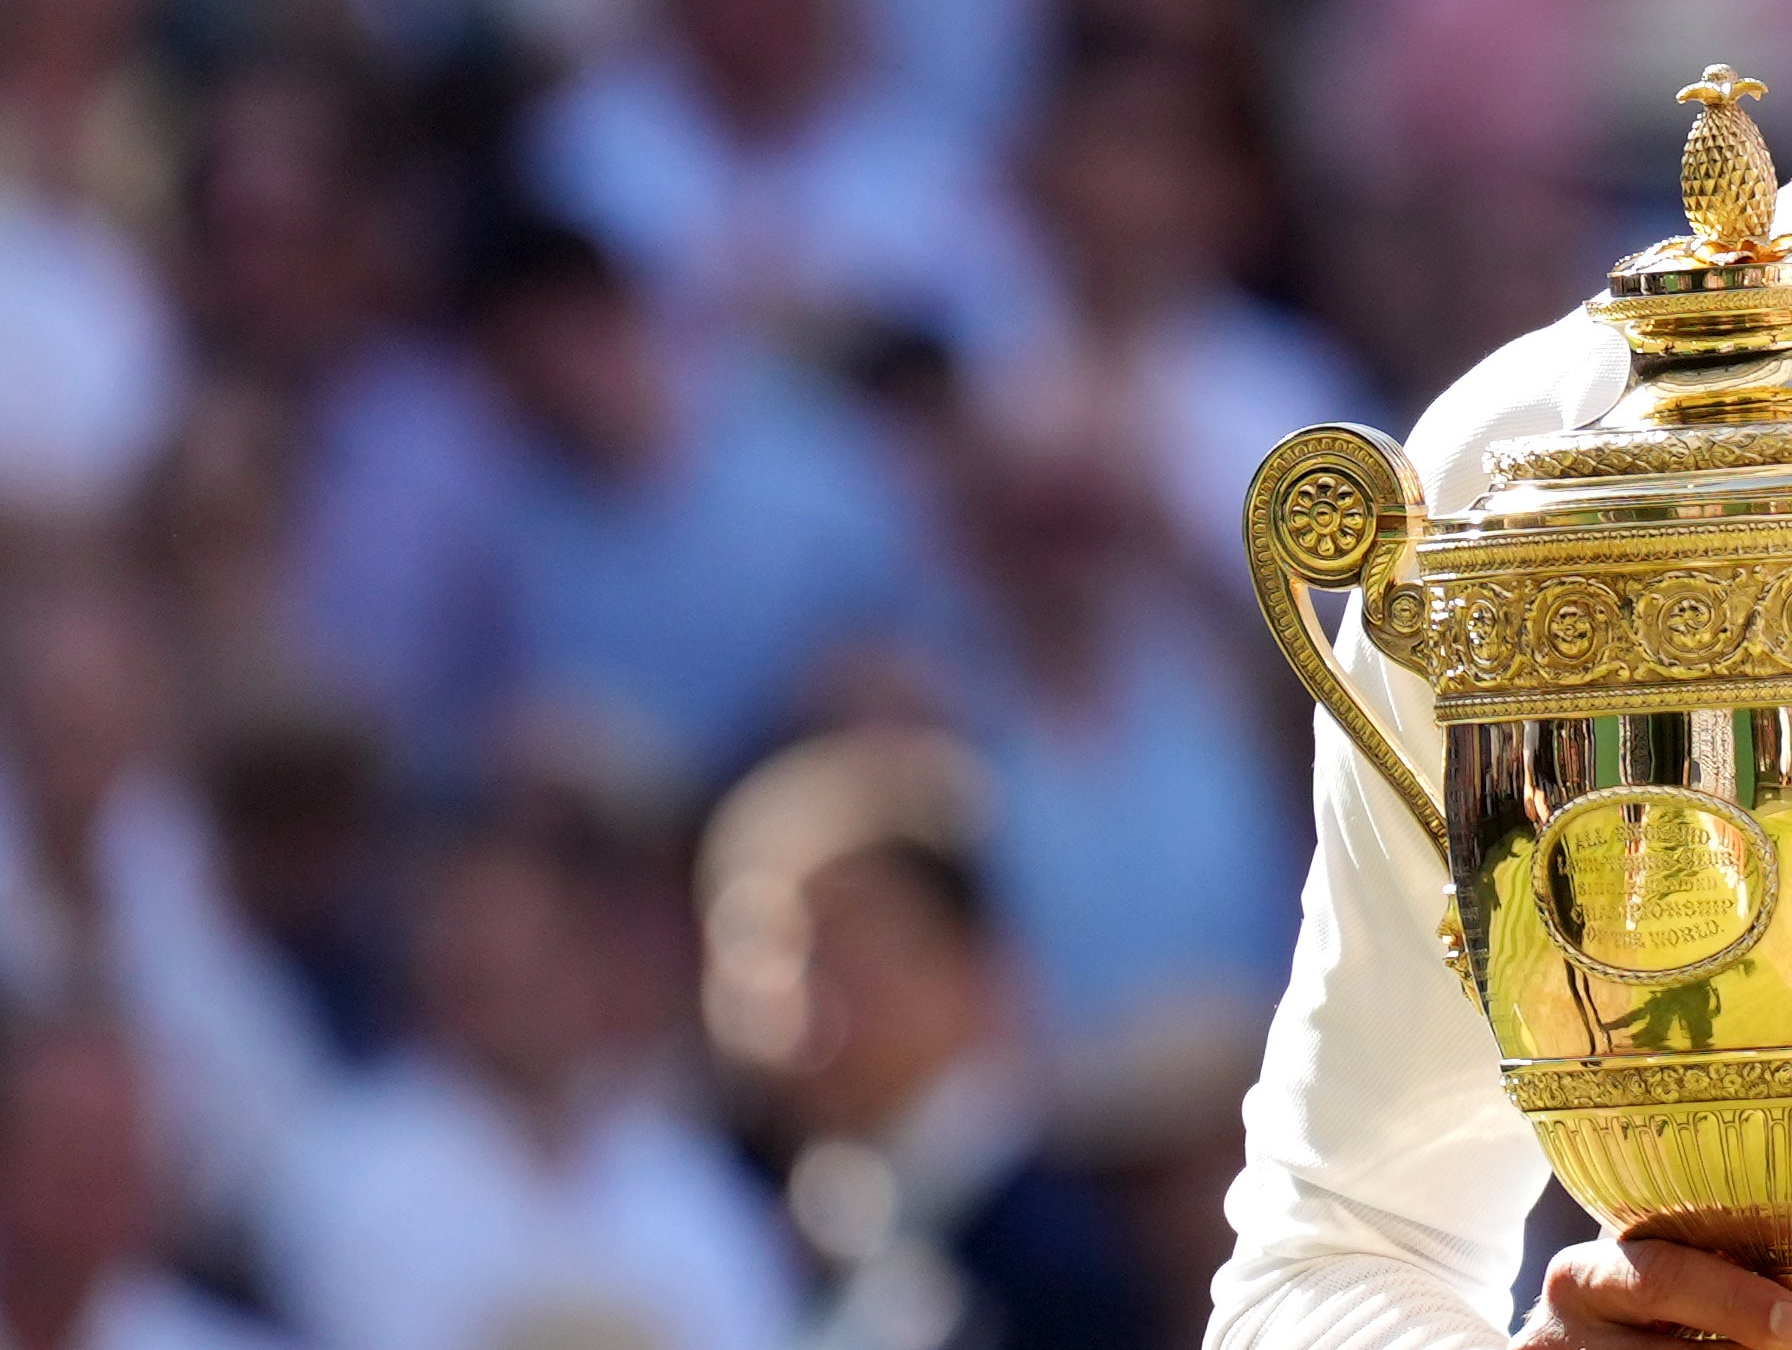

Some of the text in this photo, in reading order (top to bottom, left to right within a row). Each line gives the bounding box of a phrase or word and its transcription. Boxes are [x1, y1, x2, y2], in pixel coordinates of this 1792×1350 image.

[1575, 830, 1608, 851] ALL
[1570, 898, 1736, 924] CHAMPIONSHIP
[1648, 918, 1726, 949] WORLD.
